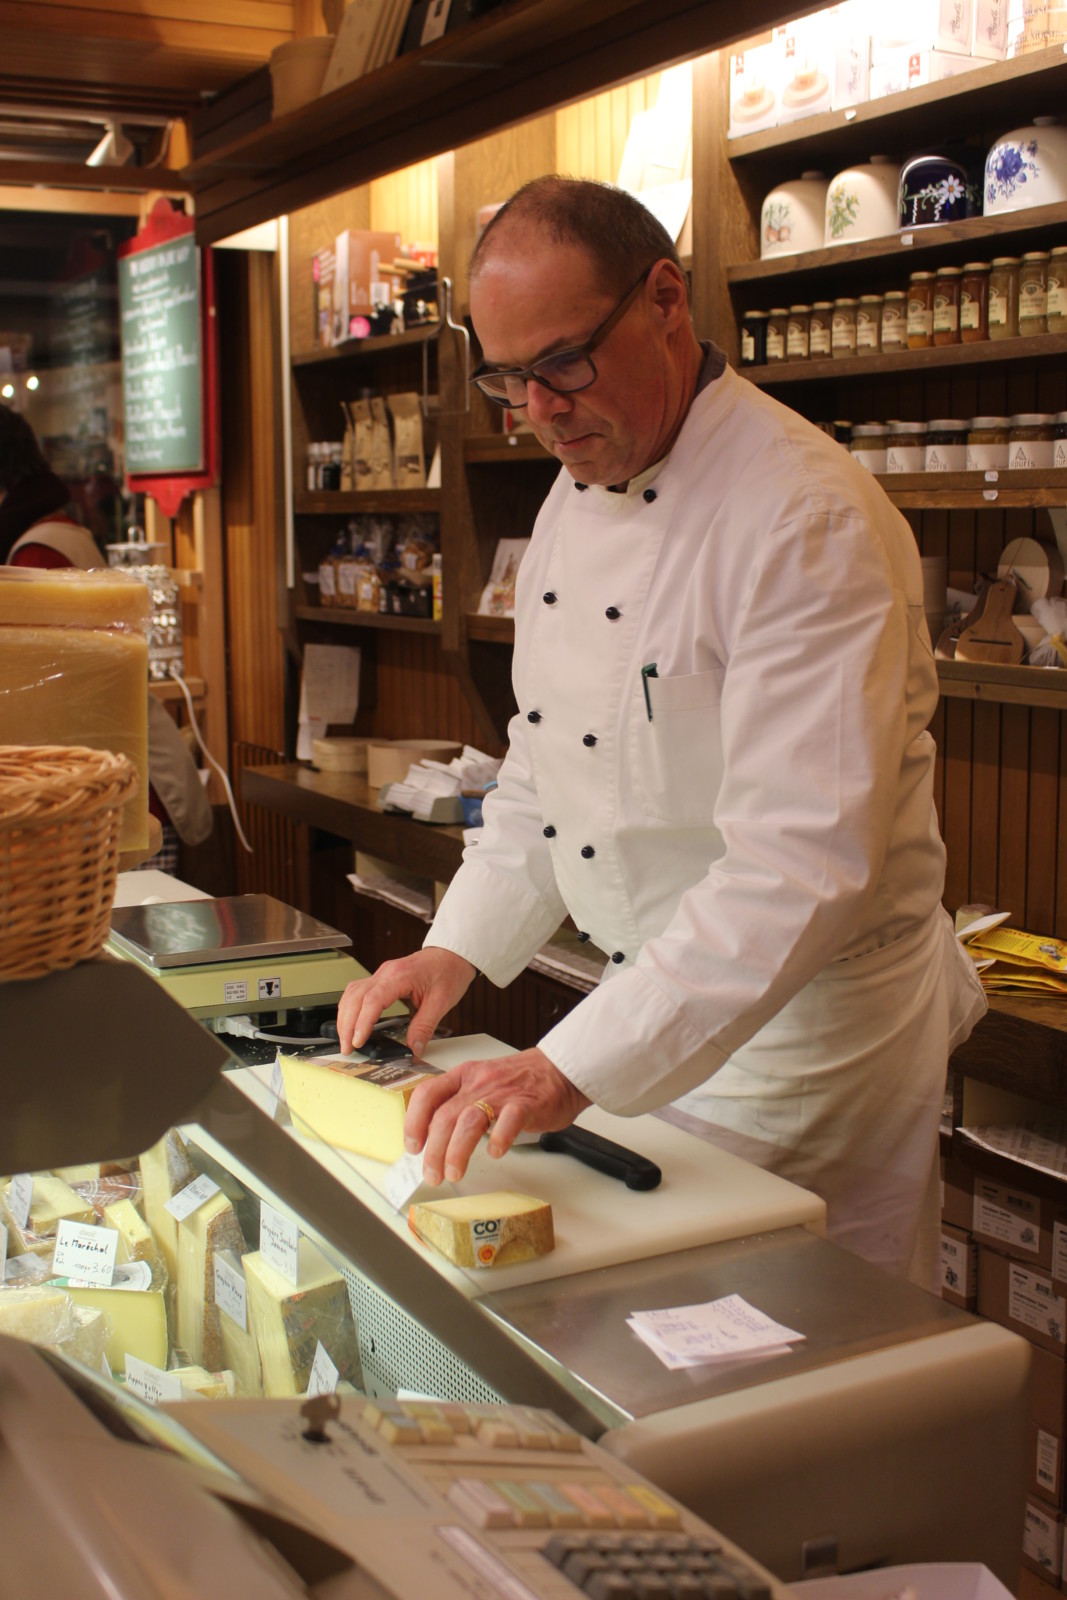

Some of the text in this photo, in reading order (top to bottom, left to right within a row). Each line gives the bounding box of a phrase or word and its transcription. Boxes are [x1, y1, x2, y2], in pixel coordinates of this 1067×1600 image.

[473, 1219, 500, 1235] CO
[59, 1236, 109, 1255] Le Maréchal
